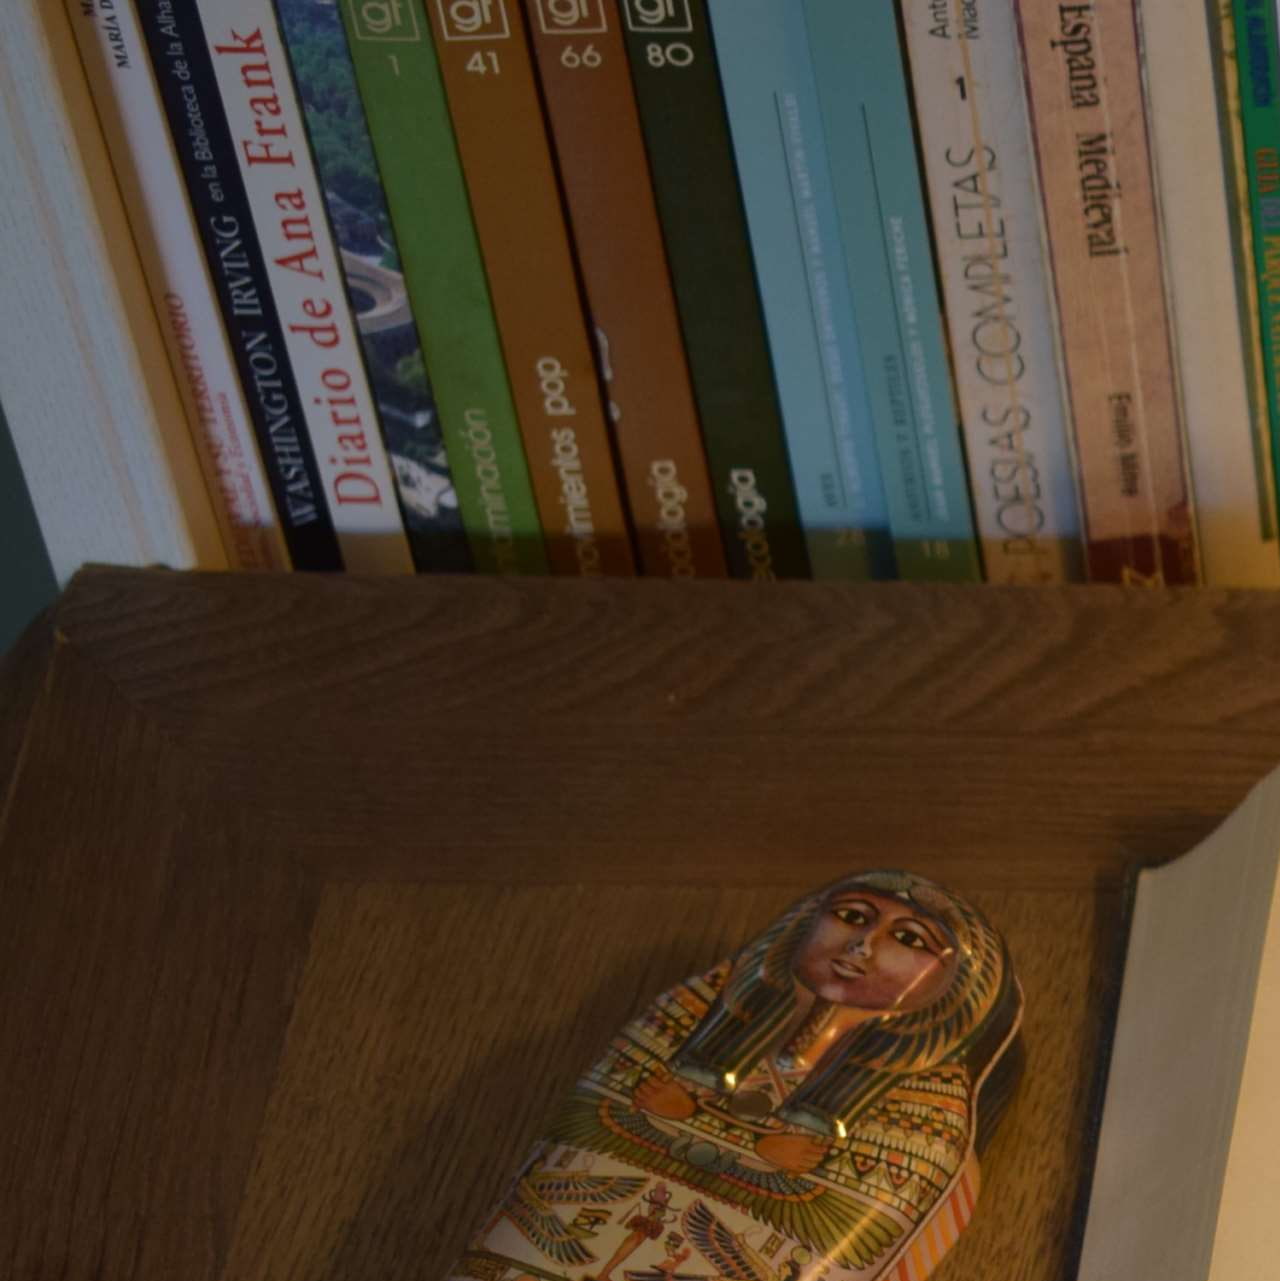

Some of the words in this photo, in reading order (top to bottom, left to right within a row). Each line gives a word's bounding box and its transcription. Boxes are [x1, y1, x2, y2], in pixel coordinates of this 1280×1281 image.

[167, 41, 185, 56] la
[172, 59, 192, 81] de
[388, 55, 400, 76] 1
[465, 51, 501, 76] 41
[560, 44, 602, 69] 66
[646, 42, 694, 67] 80
[215, 30, 295, 165] Frank
[184, 84, 214, 162] Biblioteca
[201, 164, 218, 179] la
[208, 182, 225, 203] en
[1075, 132, 1130, 259] Medieval
[272, 190, 324, 281] Ana
[219, 214, 263, 317] IRVING
[945, 145, 1026, 386] COMPLETAS
[289, 299, 341, 349] de
[246, 331, 317, 525] WASHINGTON
[314, 368, 382, 505] Diario
